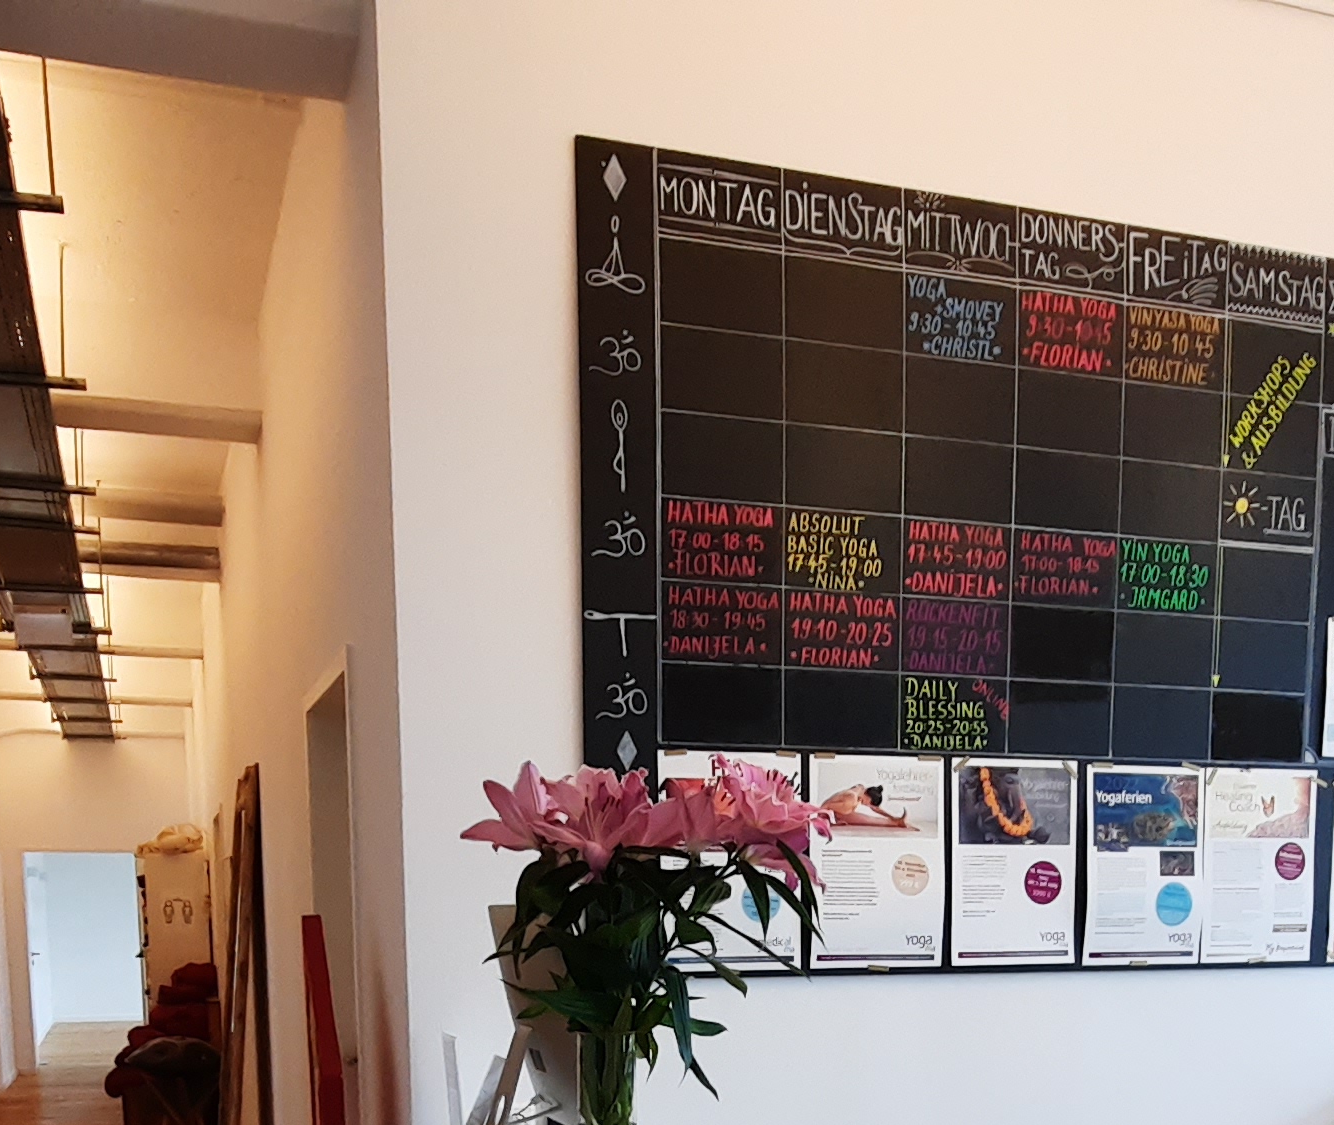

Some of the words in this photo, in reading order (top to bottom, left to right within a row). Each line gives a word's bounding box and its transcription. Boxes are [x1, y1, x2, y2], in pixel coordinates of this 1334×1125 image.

[659, 174, 775, 228] MONTAG
[1021, 249, 1060, 280] TAG
[907, 274, 947, 303] YOGA
[1228, 260, 1324, 310] SAMSTAG
[1021, 292, 1075, 315] HATHA
[1080, 298, 1116, 321] YOGA
[1128, 306, 1186, 330] VINYASA
[1190, 315, 1220, 335] YOGA
[1029, 341, 1103, 369] FLORIAN
[1229, 355, 1292, 449] WORKSHOPS
[1241, 451, 1258, 469] &
[667, 500, 729, 525] HATHA
[734, 505, 774, 528] YOGA
[788, 511, 866, 535] ABSOLUT
[787, 534, 834, 555] BASIC
[839, 539, 878, 558] YOGA
[908, 520, 960, 543] HATHA
[964, 525, 1004, 547] YOGA
[1021, 531, 1072, 552] HATHA
[1083, 537, 1116, 557] YOGA
[674, 549, 756, 577] FLORIAN
[1121, 538, 1149, 561] YIN
[1152, 542, 1191, 564] YOGA
[668, 586, 730, 608] HATHA
[735, 590, 780, 610] YOGA
[1019, 575, 1090, 595] FLORIAN
[789, 592, 849, 615] HATHA
[853, 595, 896, 620] YOGA
[800, 646, 872, 668] FLORIAN
[905, 677, 959, 702] DAILY
[904, 699, 985, 719] BLESSING
[1095, 789, 1152, 807] Yogaferien
